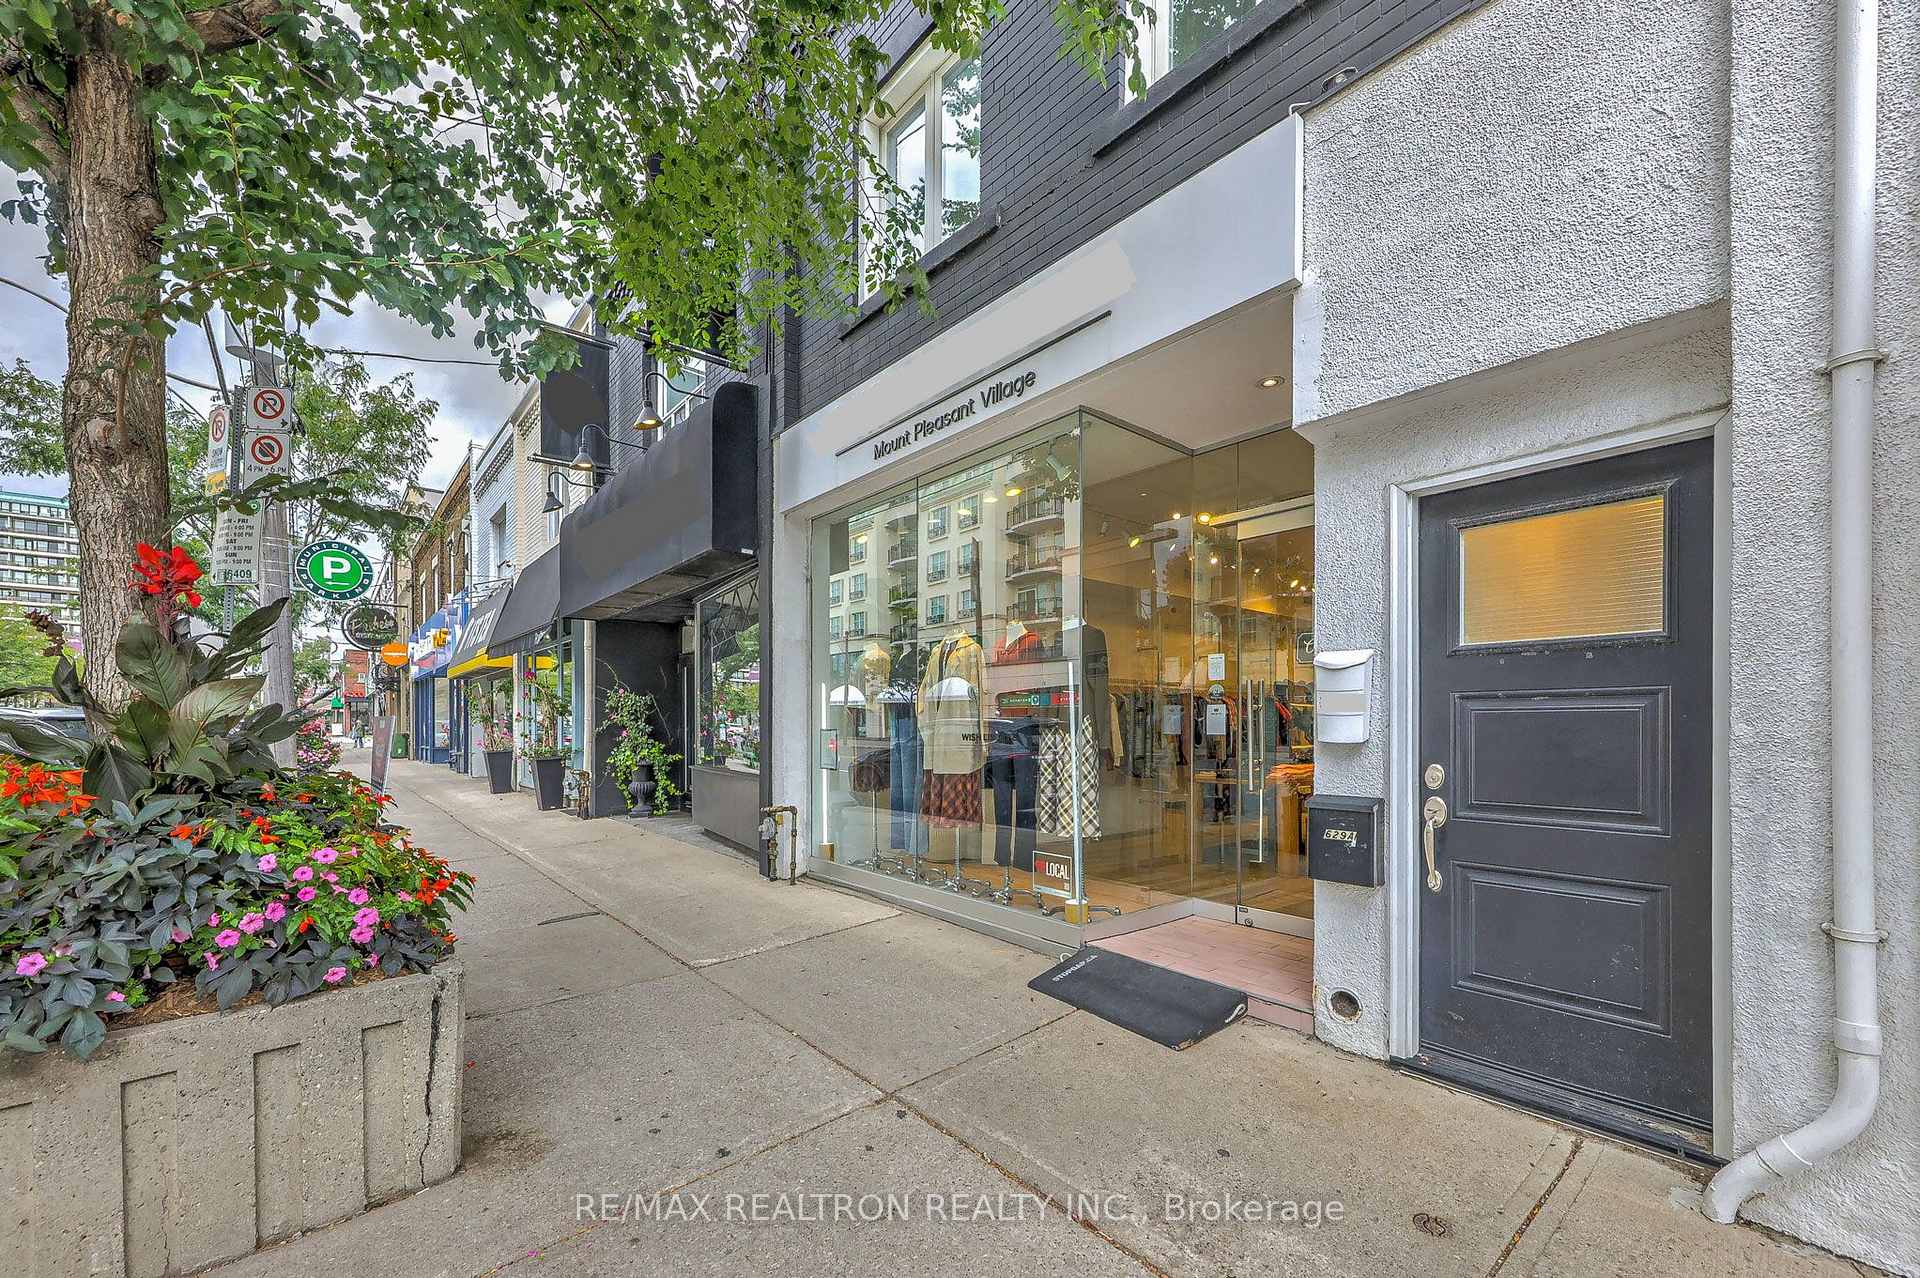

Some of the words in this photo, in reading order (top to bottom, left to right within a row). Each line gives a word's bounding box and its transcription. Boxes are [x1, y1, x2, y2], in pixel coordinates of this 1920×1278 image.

[873, 430, 912, 460] Mount
[914, 399, 976, 442] Pleasant
[980, 371, 1037, 408] Village
[299, 543, 370, 572] MUNICIPAL
[322, 556, 351, 579] P
[301, 573, 369, 599] PARKING
[1045, 861, 1070, 880] LOCAL
